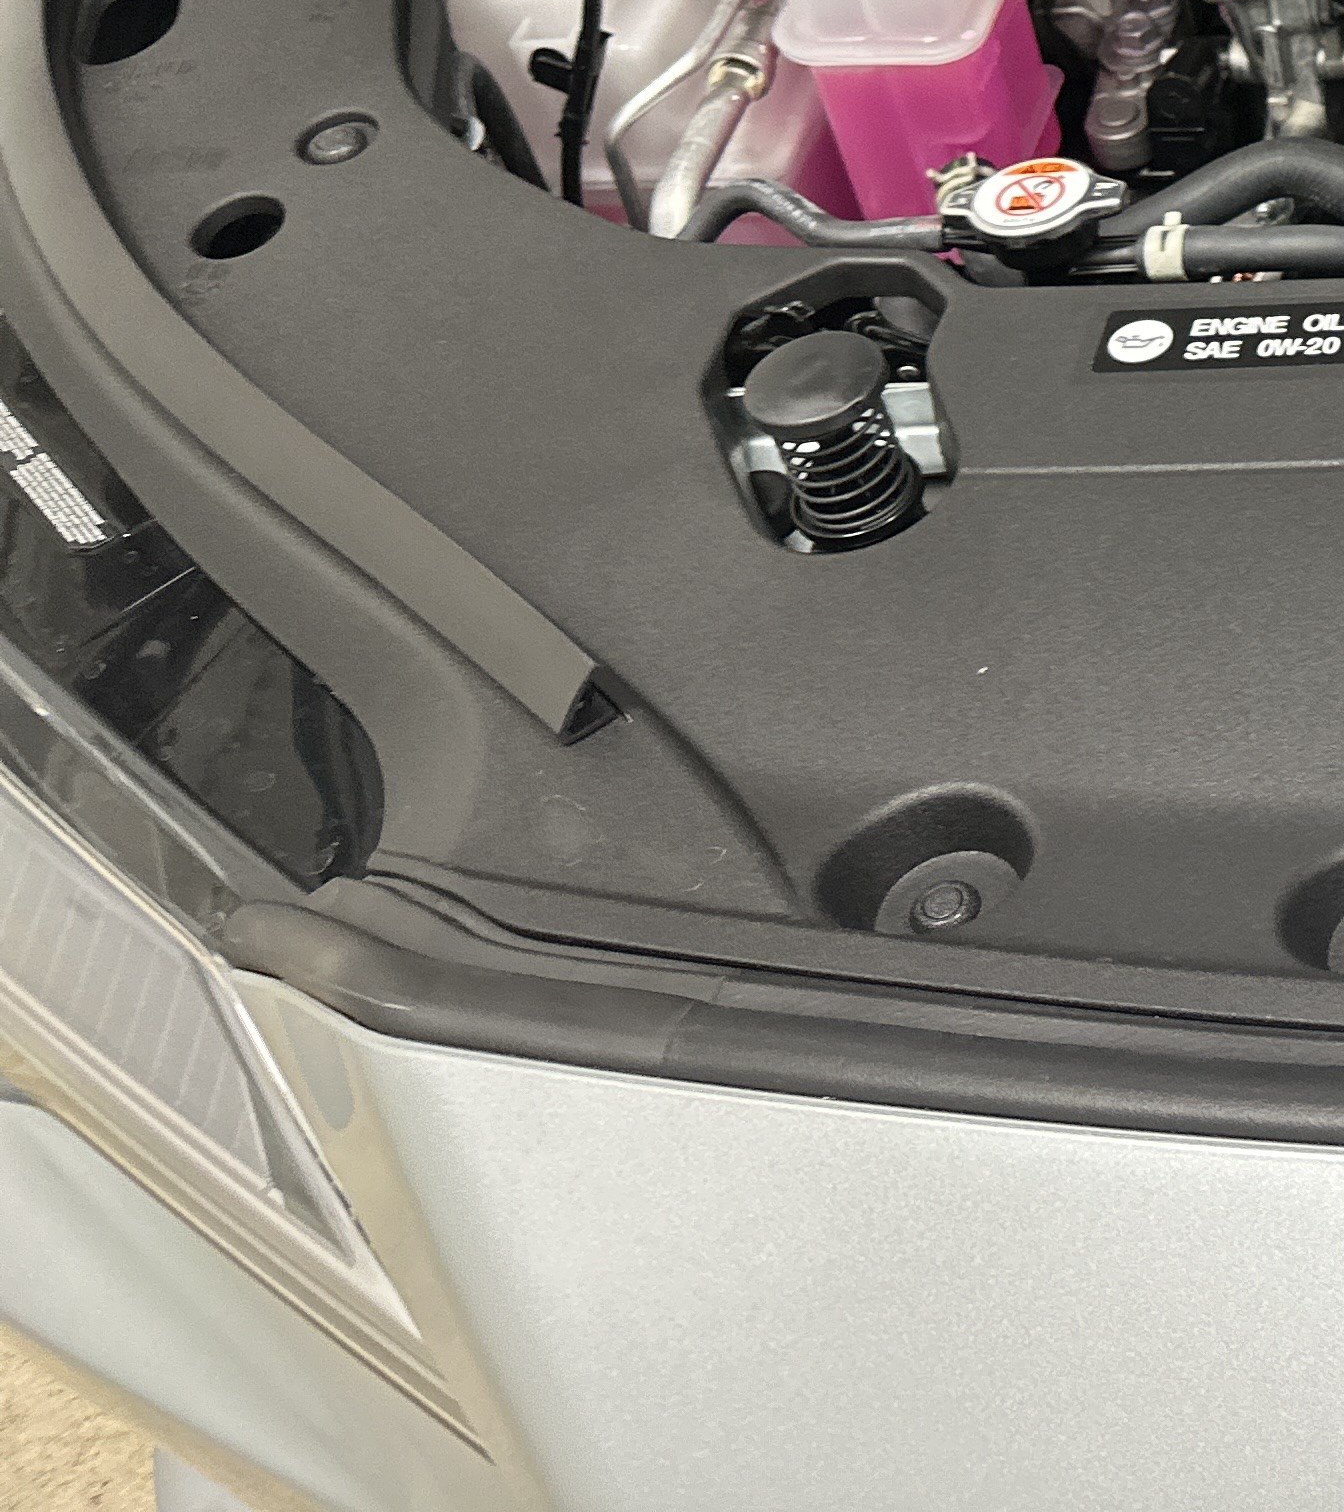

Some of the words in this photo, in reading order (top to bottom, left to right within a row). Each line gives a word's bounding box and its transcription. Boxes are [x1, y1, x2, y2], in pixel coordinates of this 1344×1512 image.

[1189, 315, 1291, 337] ENGINE
[1183, 340, 1243, 360] SAE
[1256, 336, 1342, 357] 0W-20
